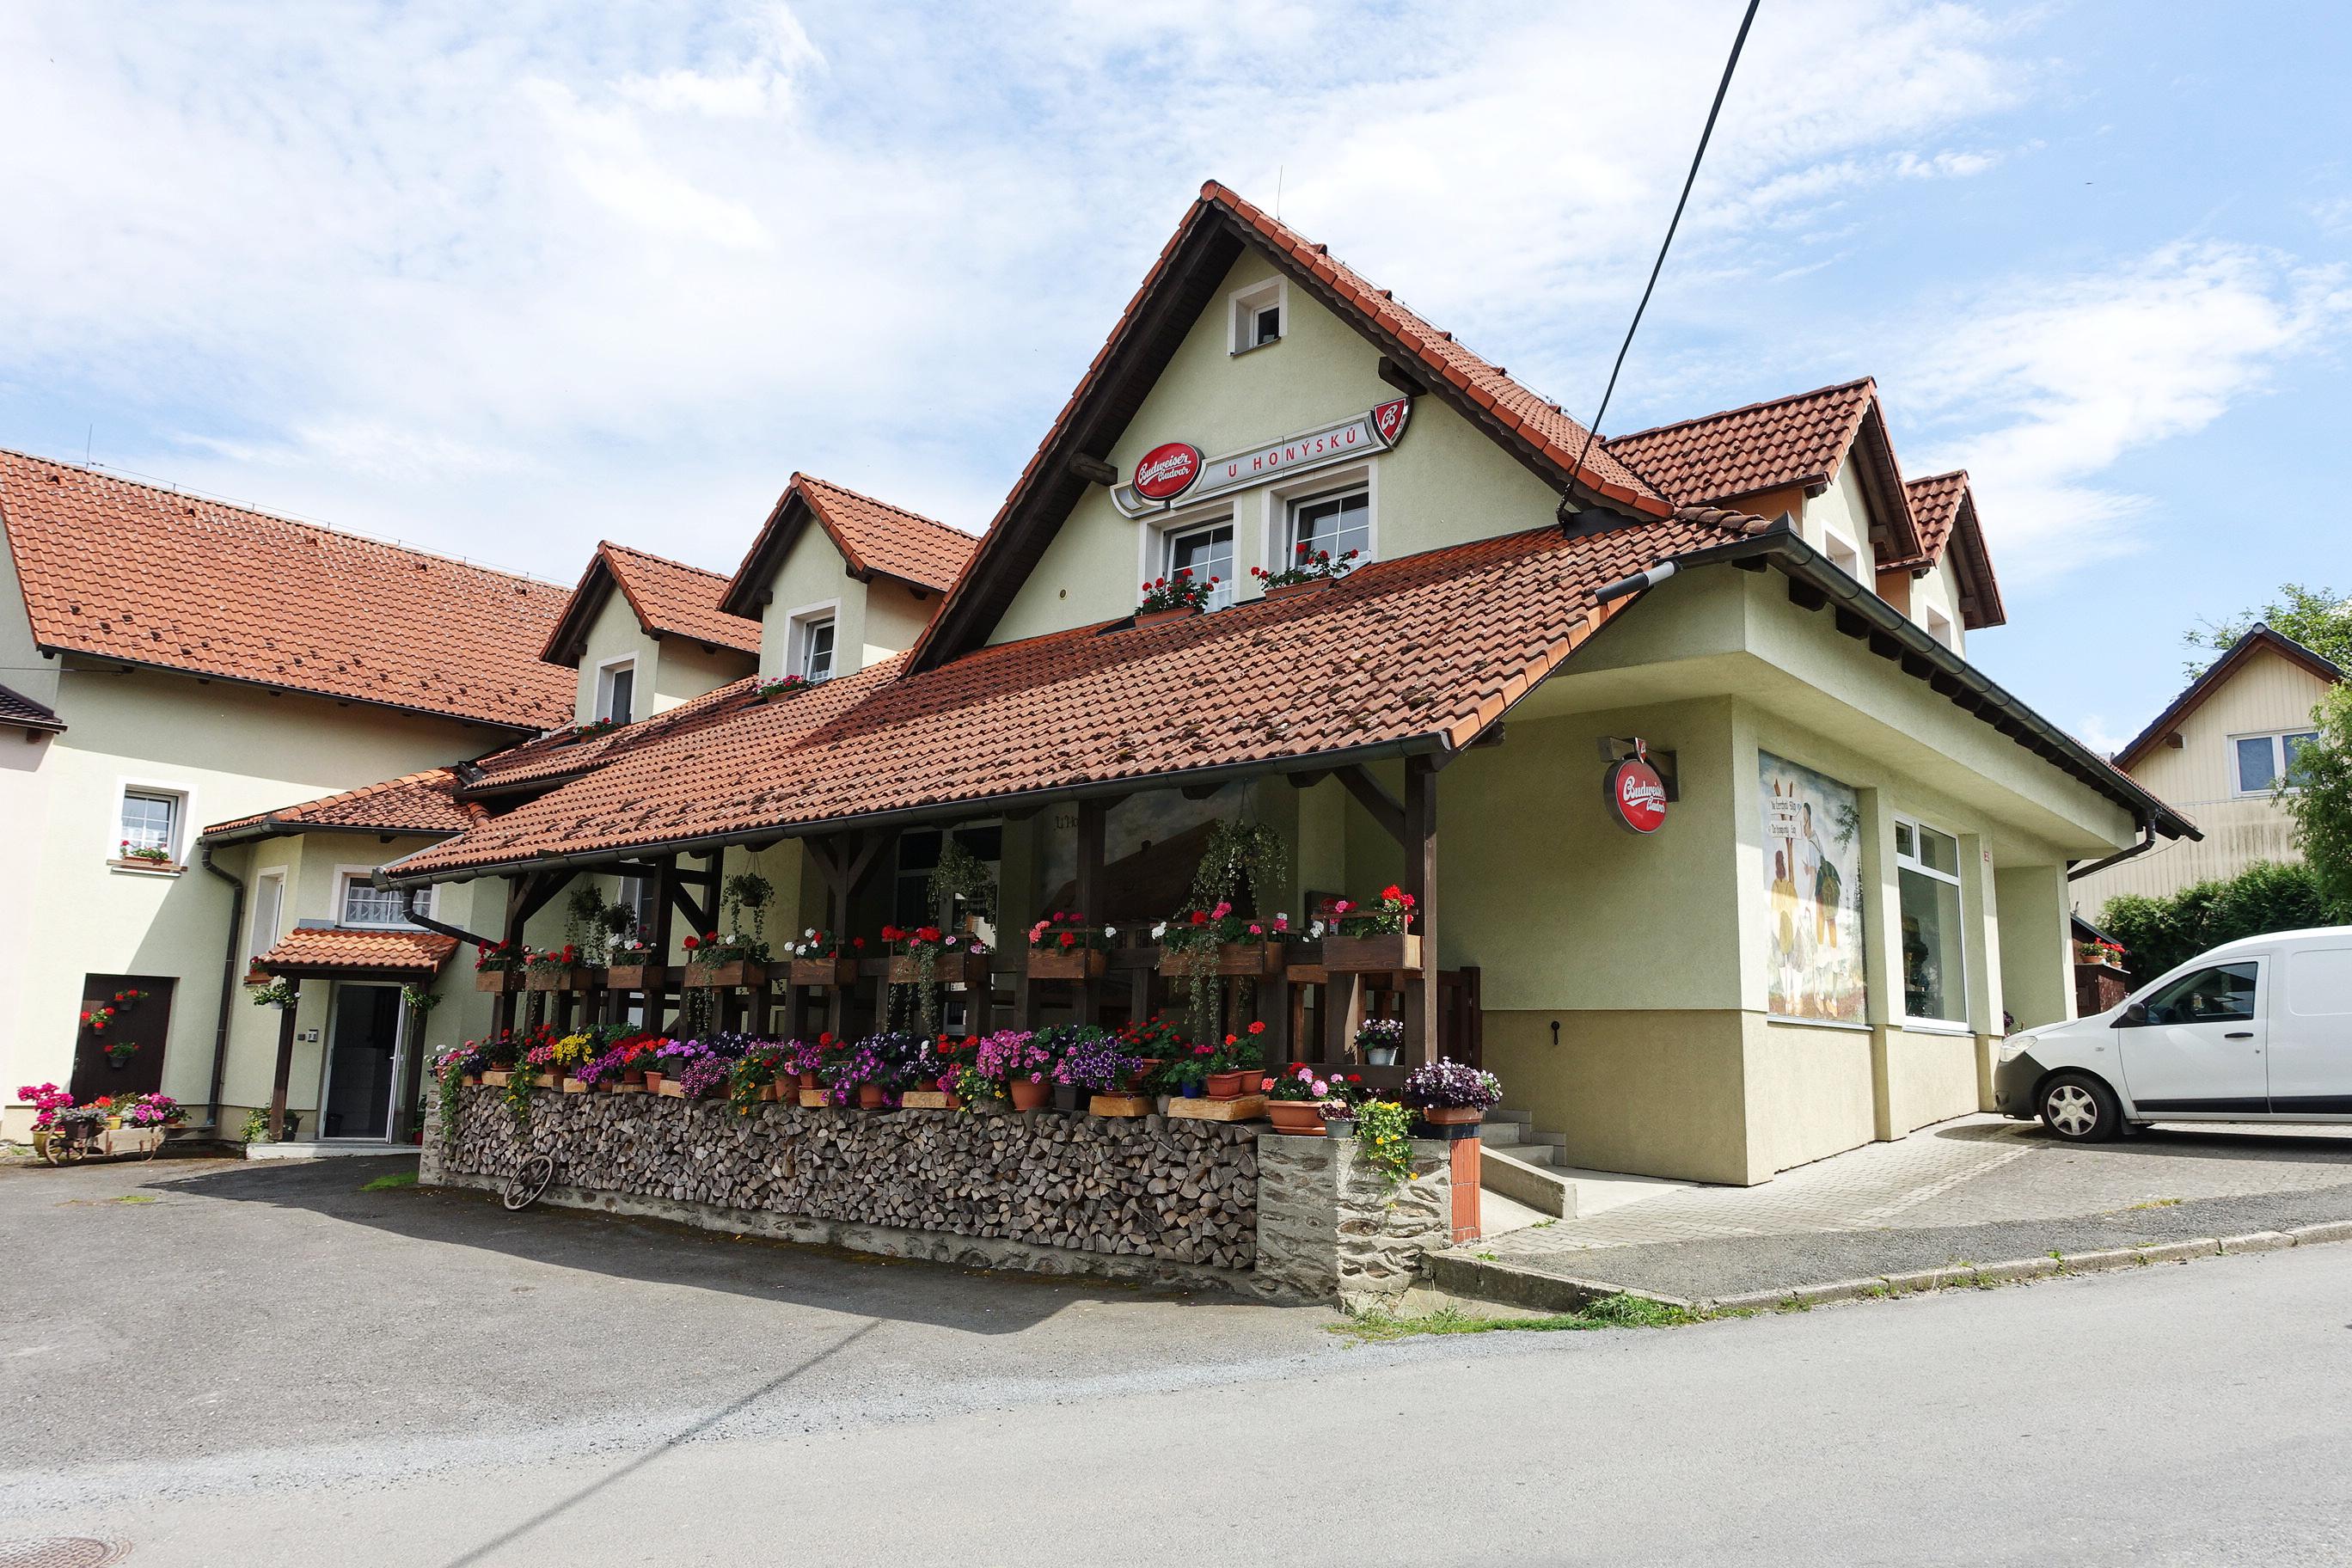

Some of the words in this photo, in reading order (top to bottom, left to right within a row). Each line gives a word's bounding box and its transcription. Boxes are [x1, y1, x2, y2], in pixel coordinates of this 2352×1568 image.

[1228, 463, 1237, 478] U
[1253, 426, 1356, 471] HONÝSKŮ
[1138, 453, 1191, 485] Budweiser
[1158, 466, 1190, 482] Budvar
